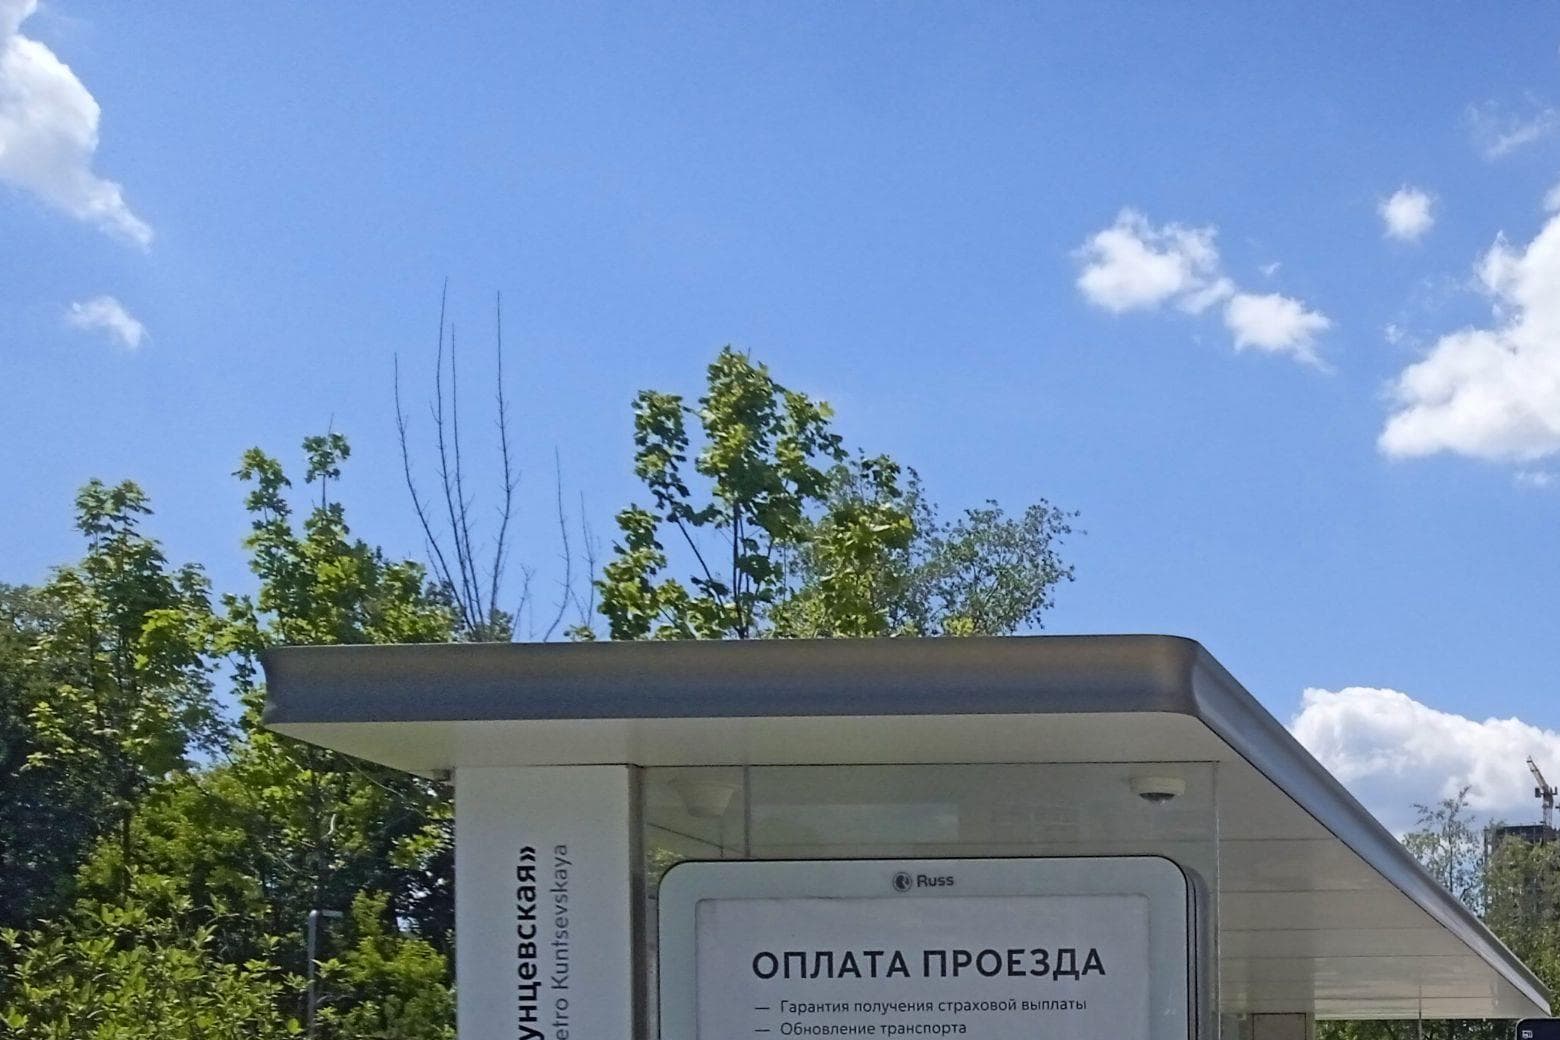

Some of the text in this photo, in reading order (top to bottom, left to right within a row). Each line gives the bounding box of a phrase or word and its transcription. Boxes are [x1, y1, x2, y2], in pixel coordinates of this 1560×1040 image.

[917, 874, 954, 888] Russ
[550, 844, 573, 989] Kuntsevskaya
[752, 947, 1106, 982] ОПЛАТА ПРОЕЗДА
[780, 998, 1087, 1016] Гарантия получения страховой выплаты
[780, 1022, 967, 1038] Обновление транспорта
